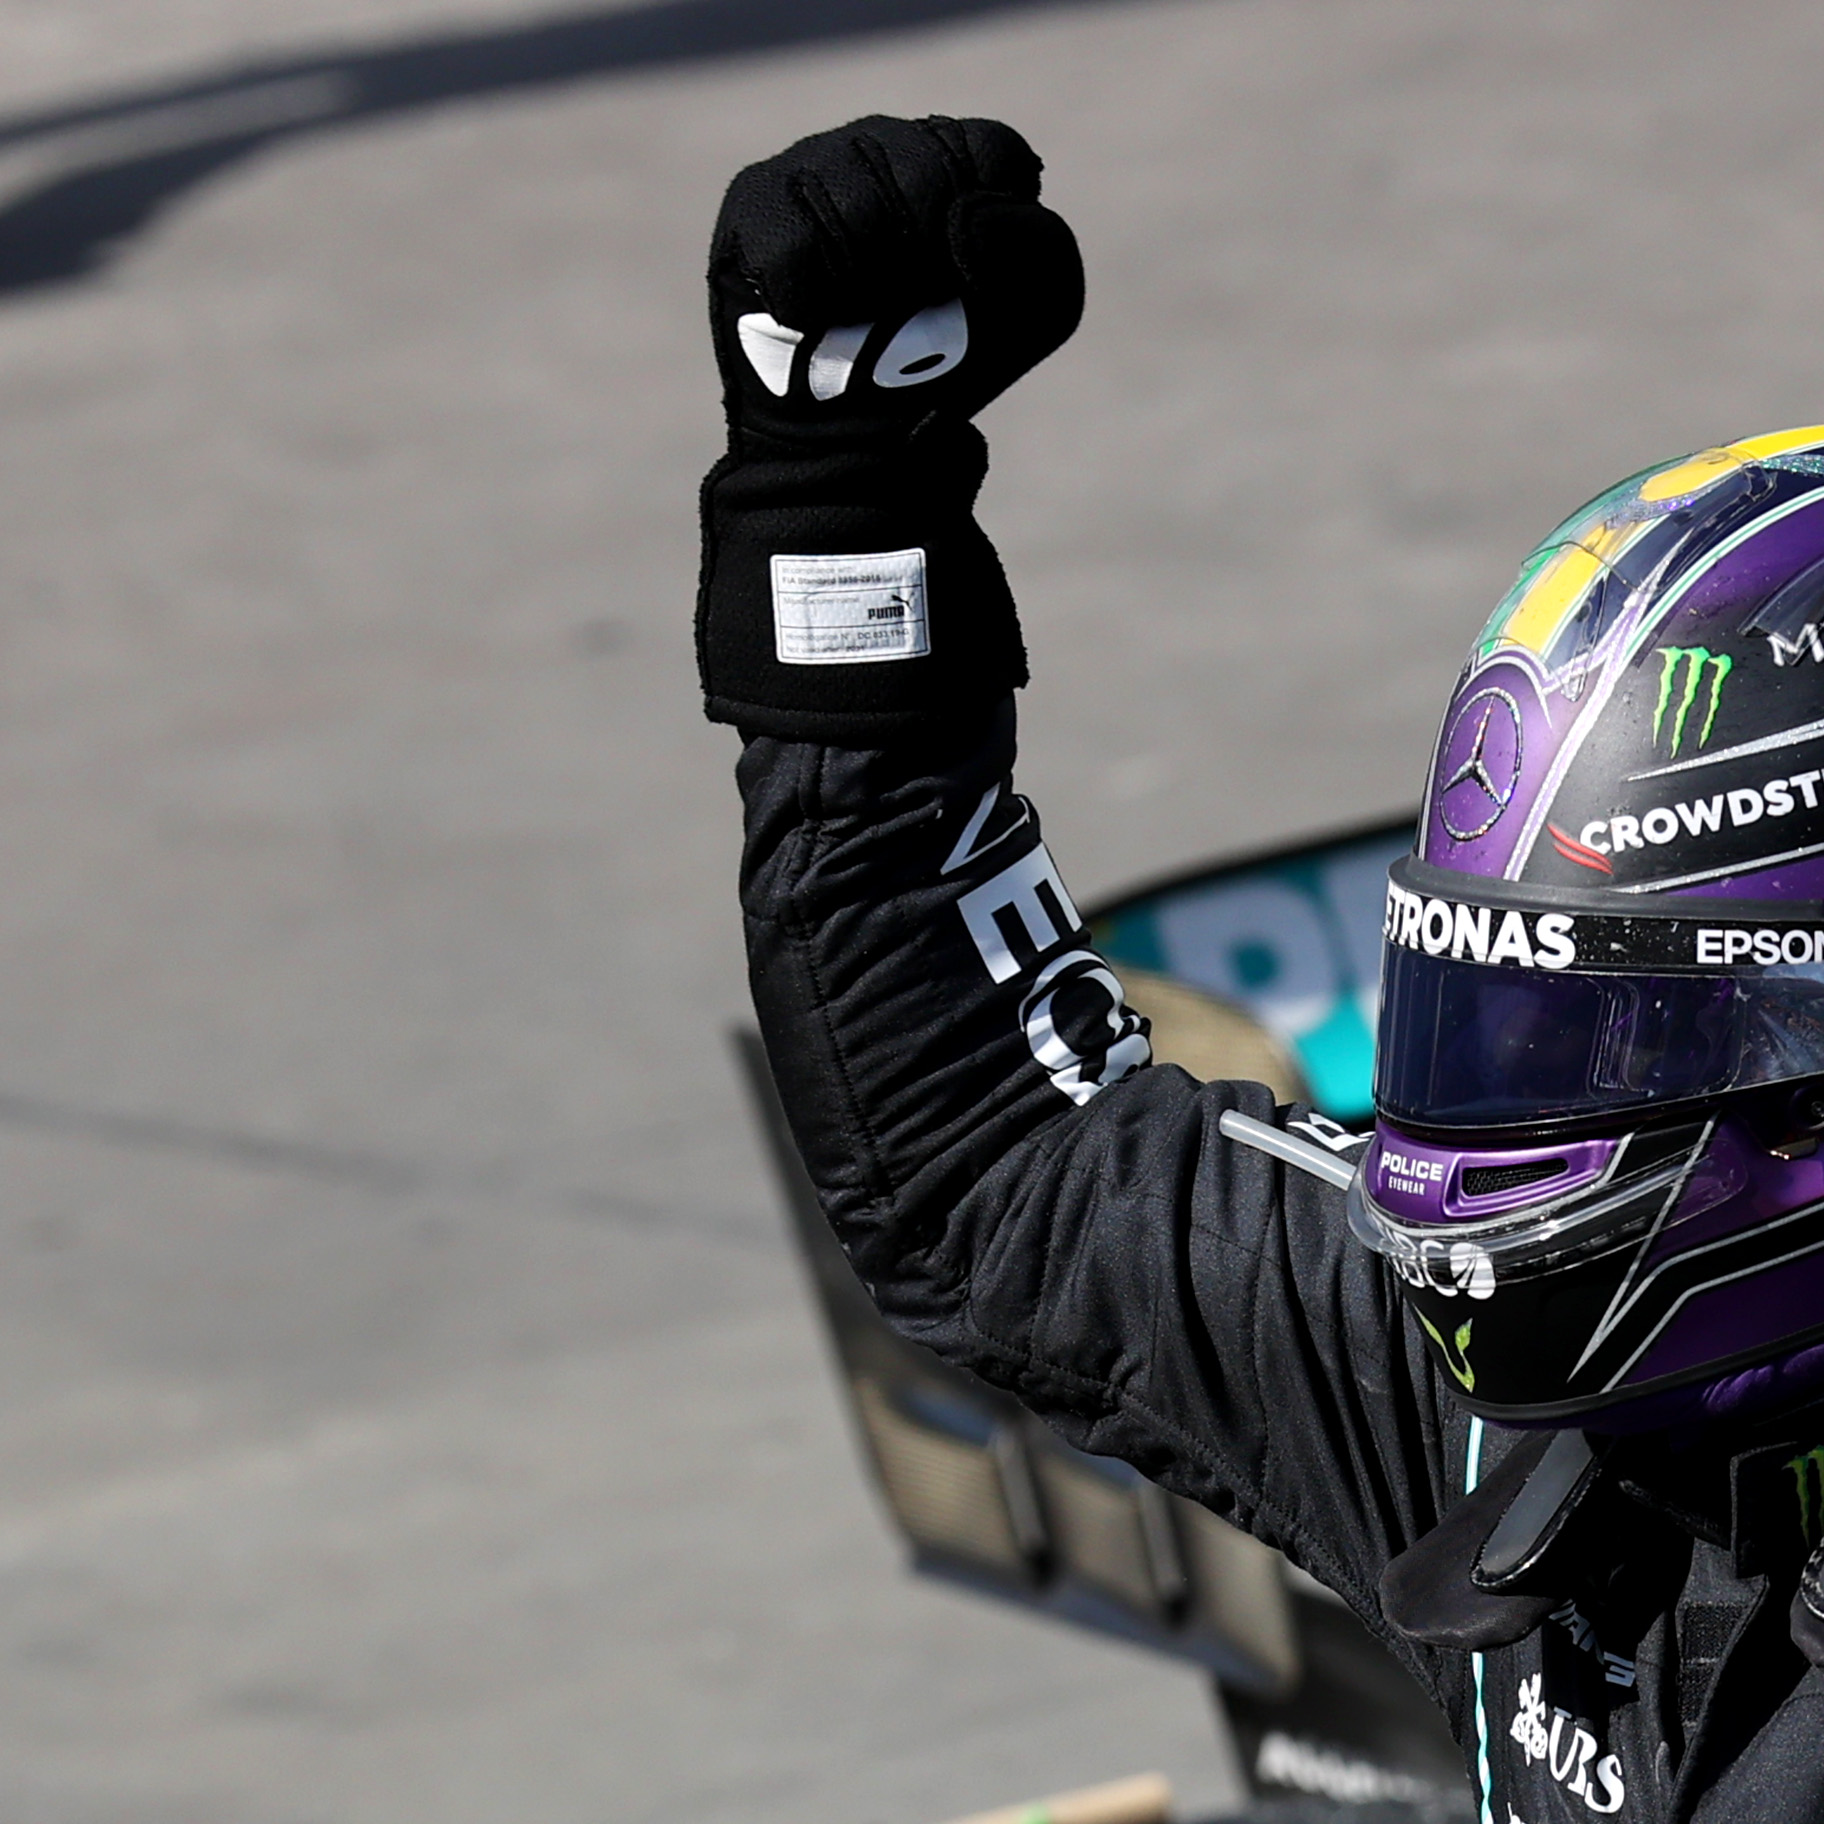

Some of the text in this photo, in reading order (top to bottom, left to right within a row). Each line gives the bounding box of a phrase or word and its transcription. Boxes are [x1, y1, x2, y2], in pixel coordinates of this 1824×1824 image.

[867, 605, 905, 620] PUMA
[1380, 1151, 1444, 1182] POLICE
[1388, 1176, 1425, 1196] EYEWEAR
[1549, 1706, 1626, 1814] UBS
